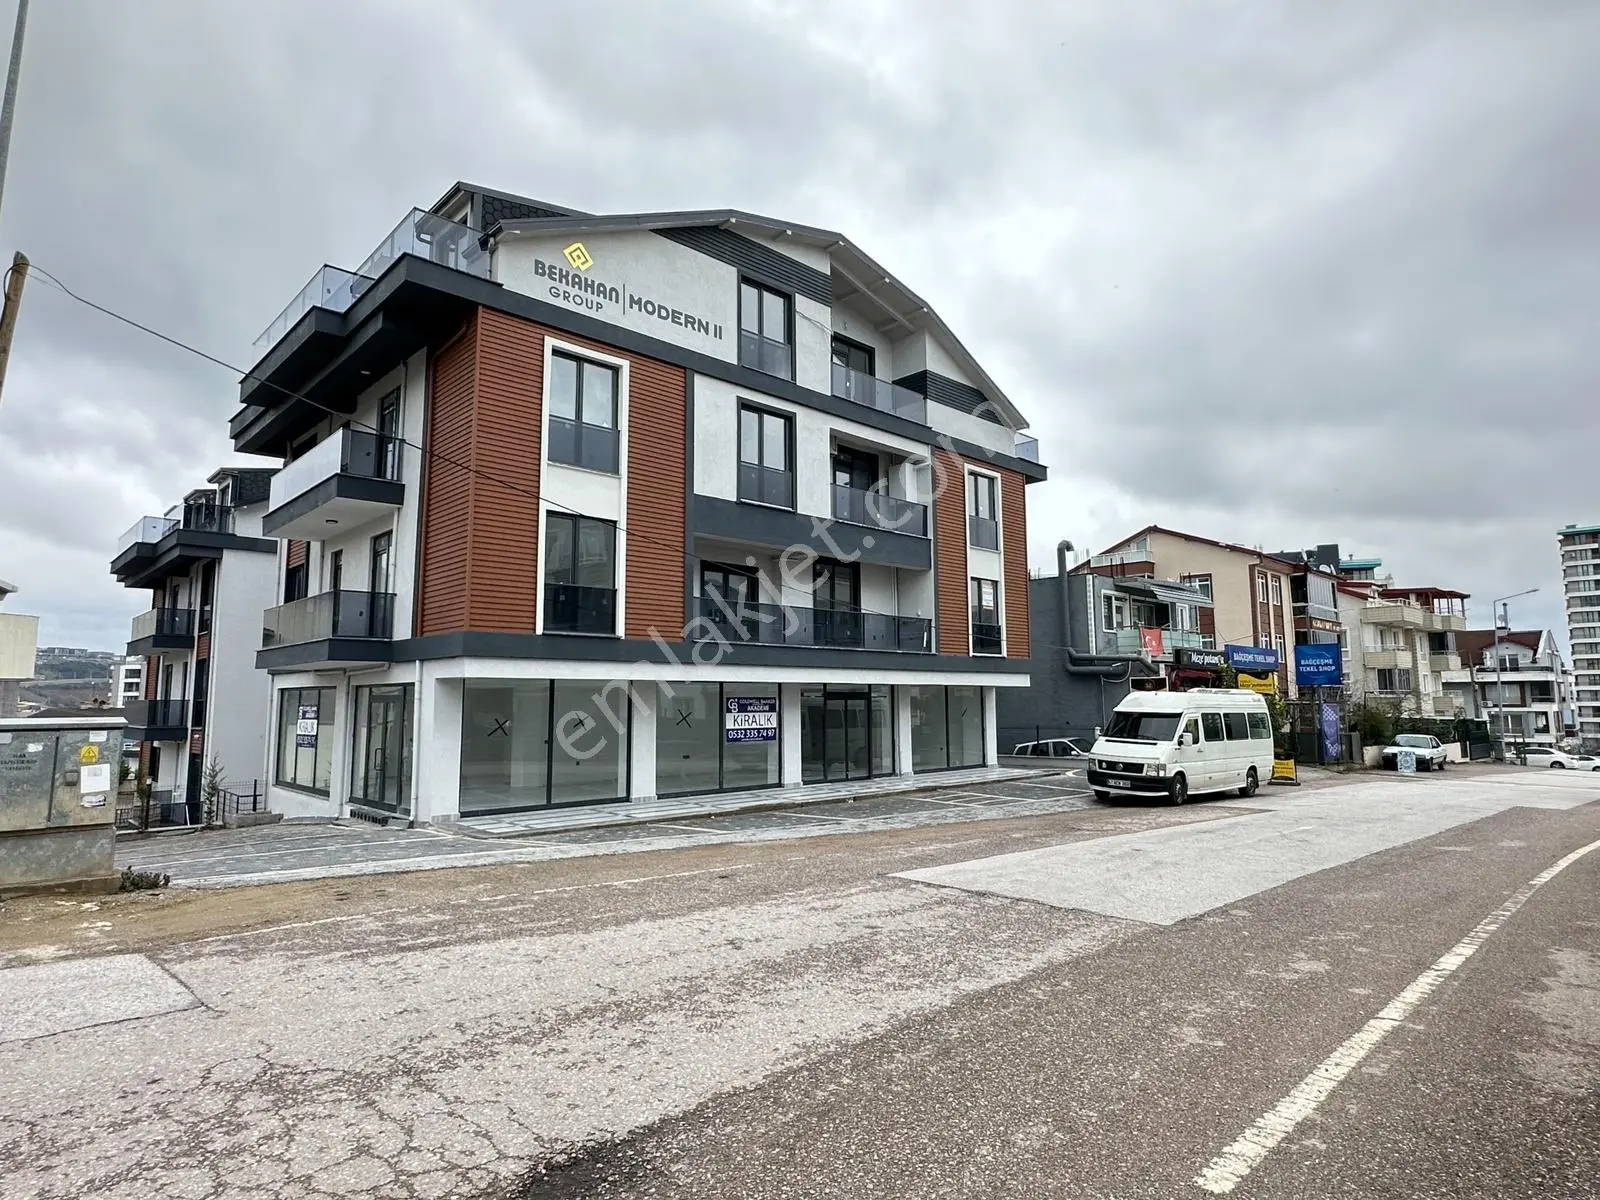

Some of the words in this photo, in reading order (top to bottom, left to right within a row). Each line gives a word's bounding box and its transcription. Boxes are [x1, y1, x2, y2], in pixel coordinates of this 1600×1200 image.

[534, 258, 620, 304] BEKAHAN
[549, 286, 604, 313] GROUP
[628, 293, 710, 336] MODERN
[1254, 654, 1266, 663] TEKEL
[1266, 655, 1276, 664] SHOP
[728, 730, 745, 739] 0532
[745, 729, 758, 738] 335
[759, 729, 767, 737] 74
[767, 729, 775, 737] 97
